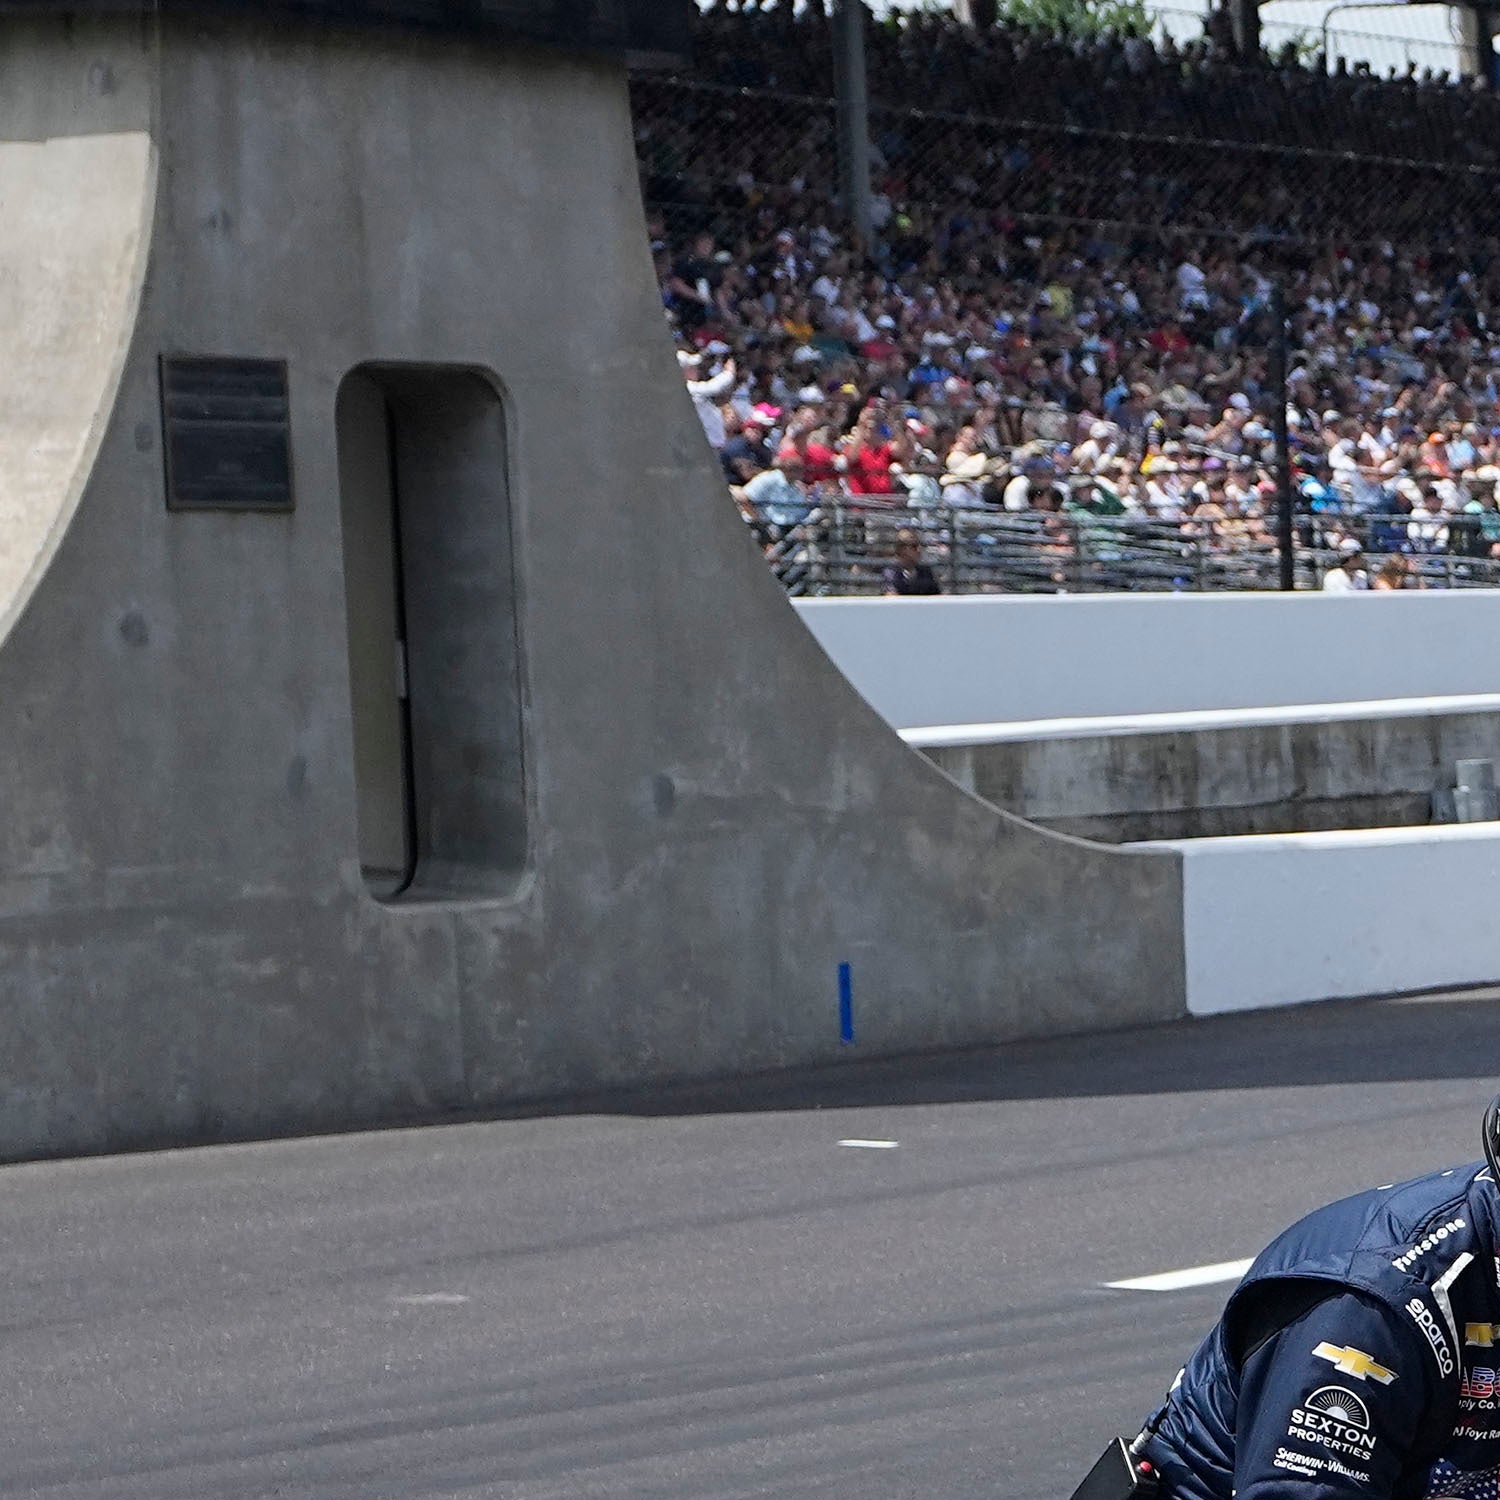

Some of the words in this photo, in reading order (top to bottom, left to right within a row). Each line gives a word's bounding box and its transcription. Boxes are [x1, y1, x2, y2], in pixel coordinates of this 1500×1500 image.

[1391, 1217, 1467, 1273] Firestone
[1405, 1298, 1454, 1376] sparco
[1287, 1425, 1372, 1461] PROPERTIES
[1290, 1408, 1377, 1450] SEXTON
